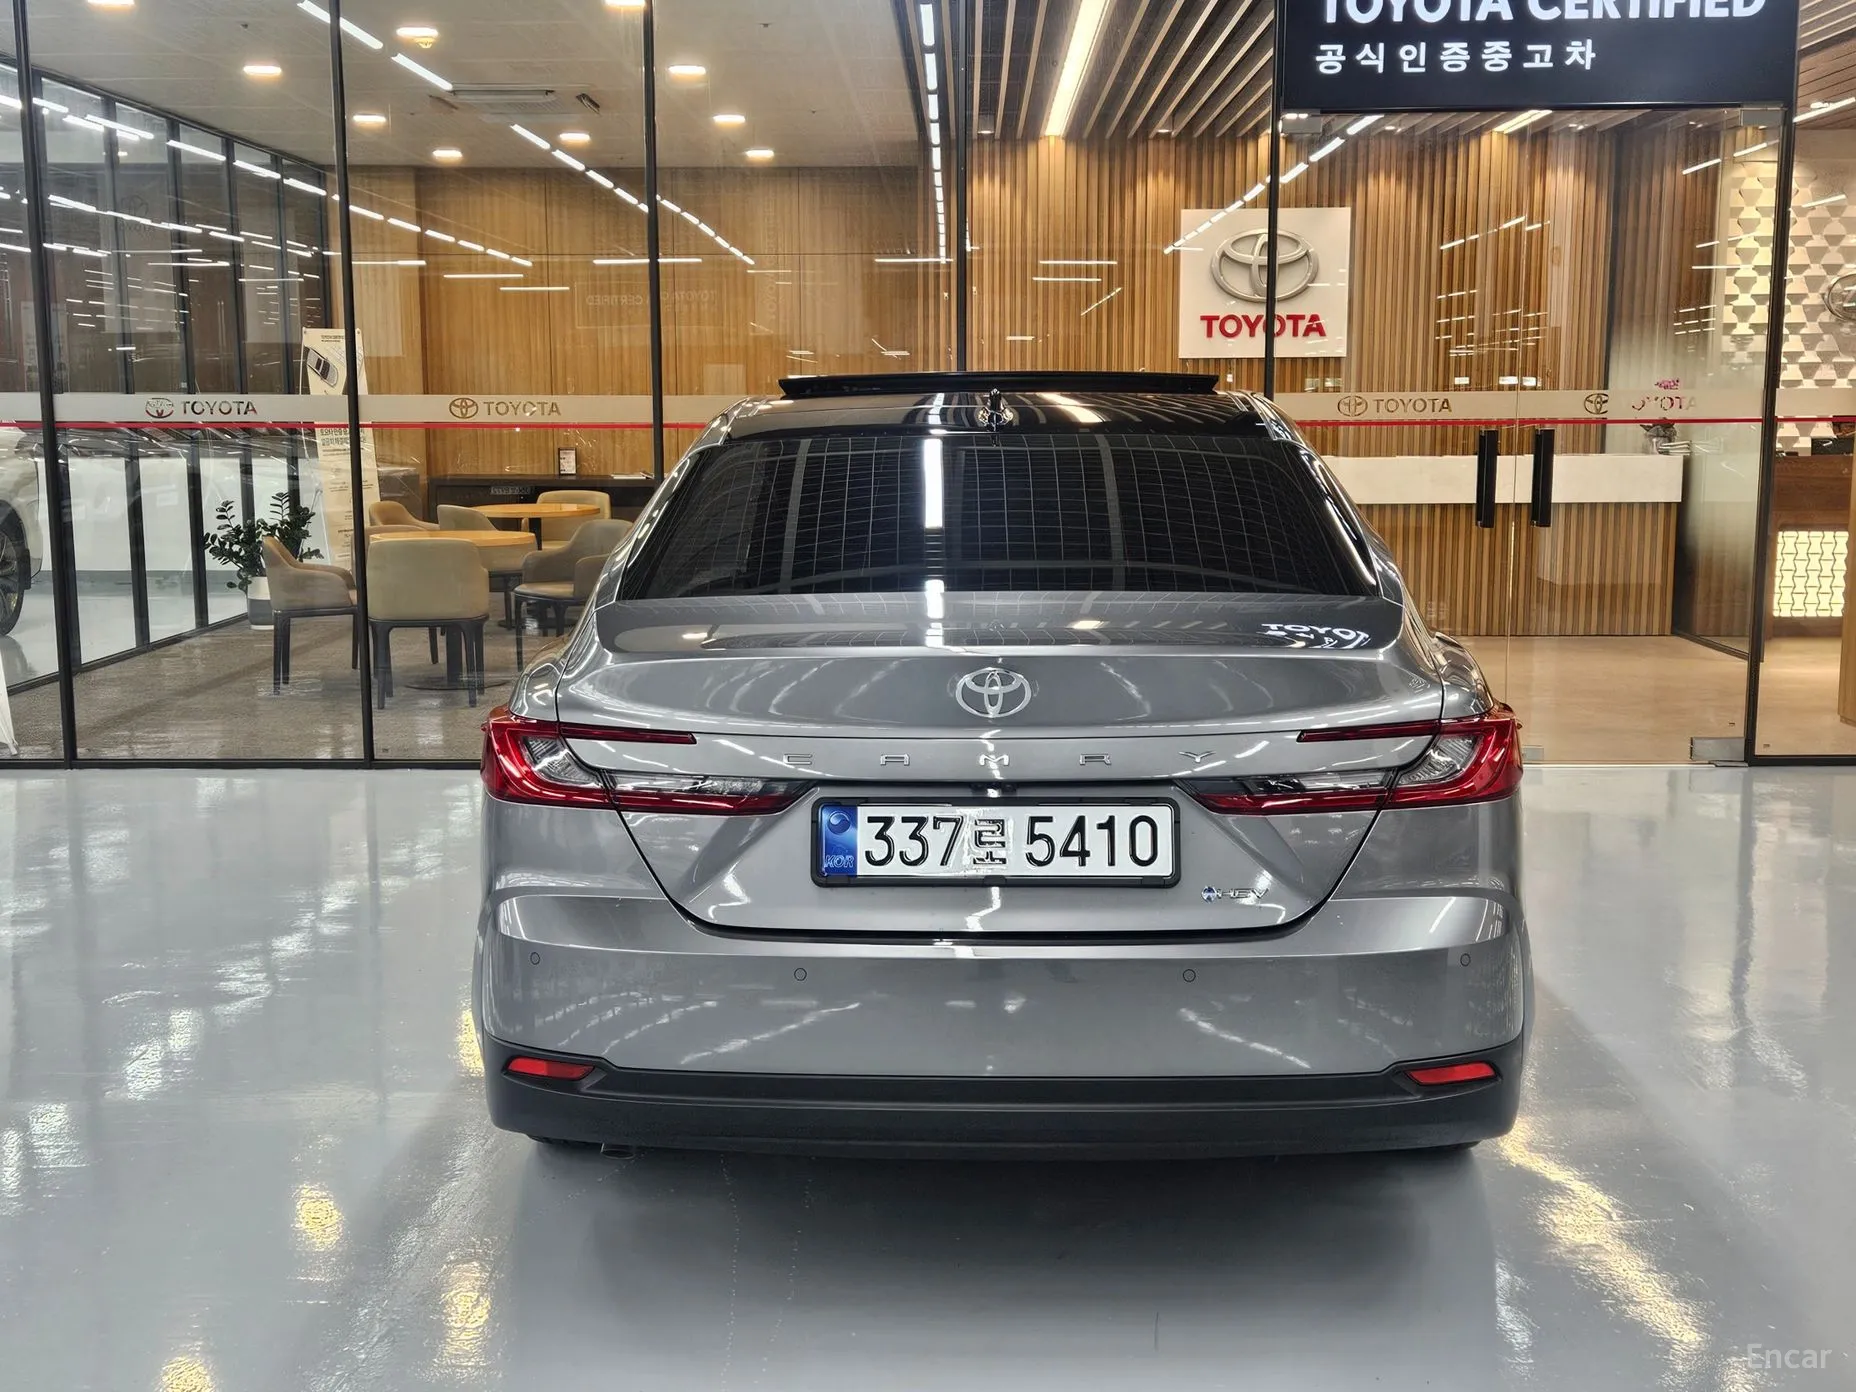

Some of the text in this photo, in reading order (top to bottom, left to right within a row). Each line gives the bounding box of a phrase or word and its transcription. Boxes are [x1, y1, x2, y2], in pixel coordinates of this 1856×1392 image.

[1200, 314, 1327, 338] TOYOTA
[182, 400, 258, 415] TOYOTA
[483, 401, 562, 416] TOYOTA
[1372, 398, 1453, 413] TOYOTA
[782, 751, 1217, 767] CAMRY
[1025, 814, 1160, 868] 5410
[824, 854, 855, 868] KOR
[1215, 888, 1269, 900] HEV
